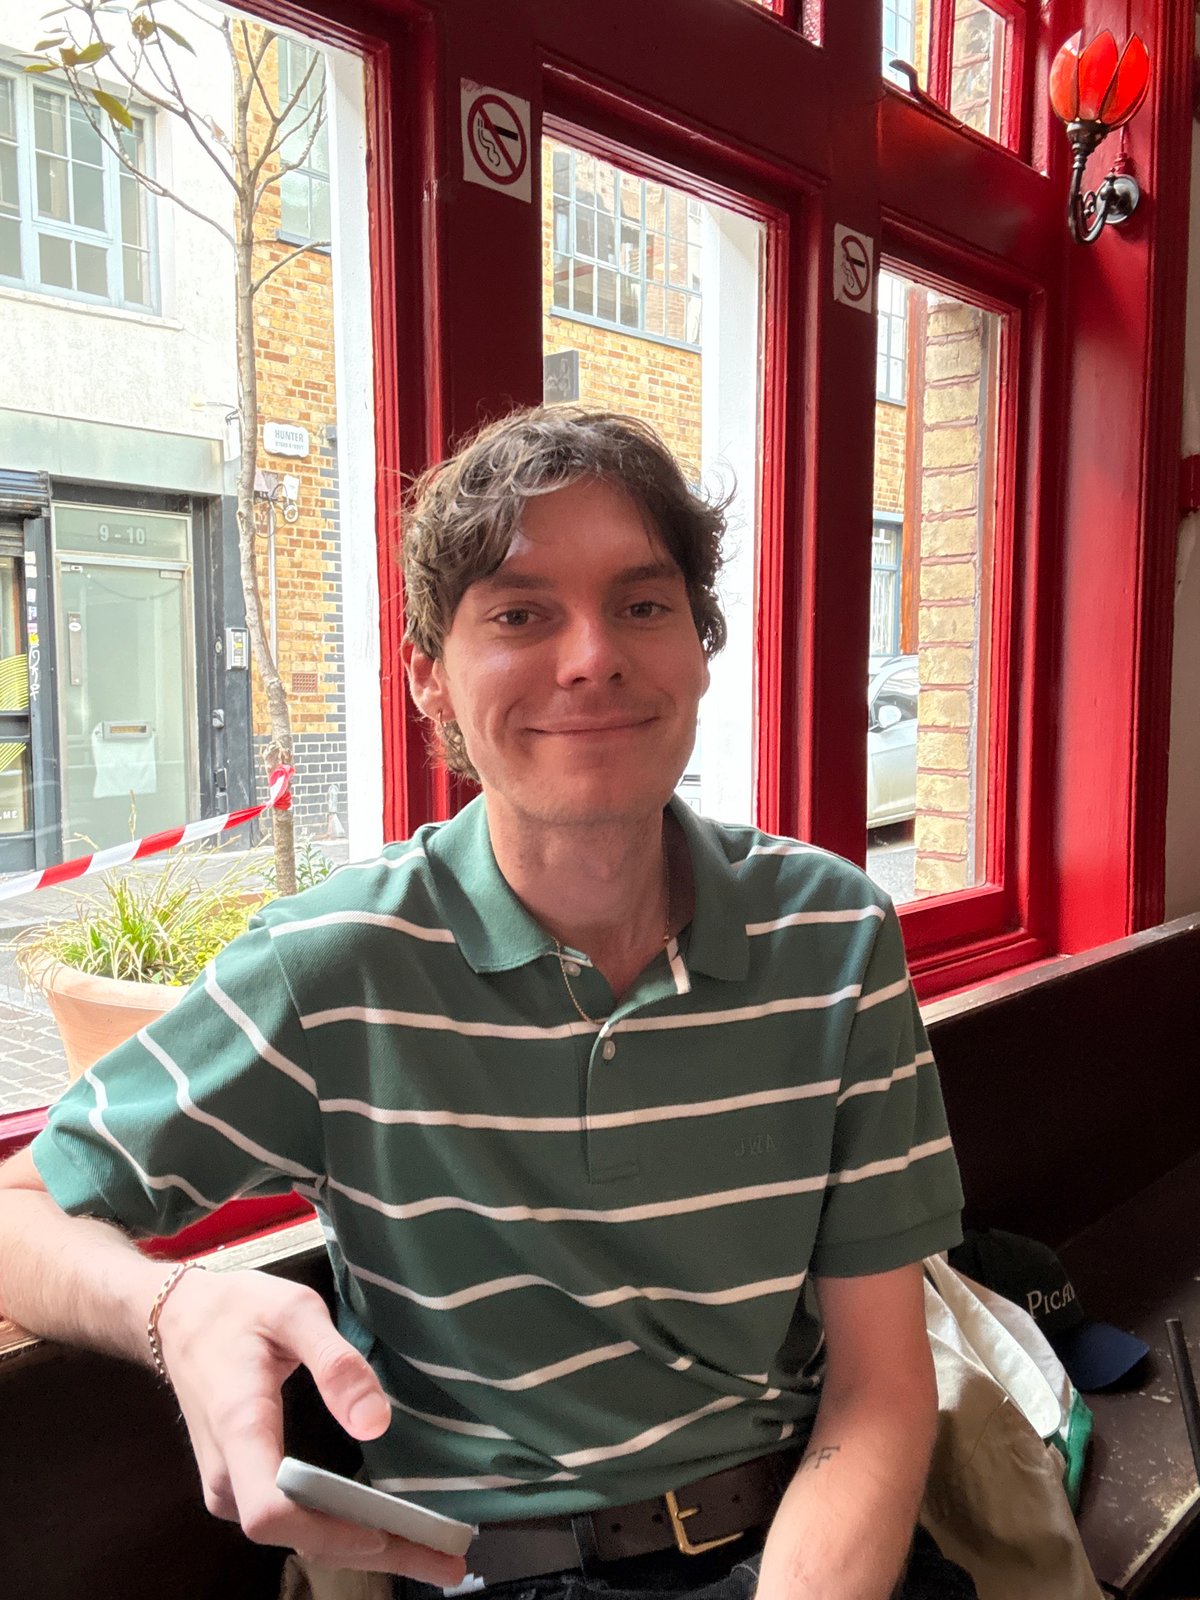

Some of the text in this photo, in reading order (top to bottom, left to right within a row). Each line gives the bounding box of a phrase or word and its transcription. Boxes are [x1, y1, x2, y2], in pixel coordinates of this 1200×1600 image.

[275, 429, 303, 442] HUNTER
[100, 524, 109, 541] 9
[126, 527, 145, 544] 10
